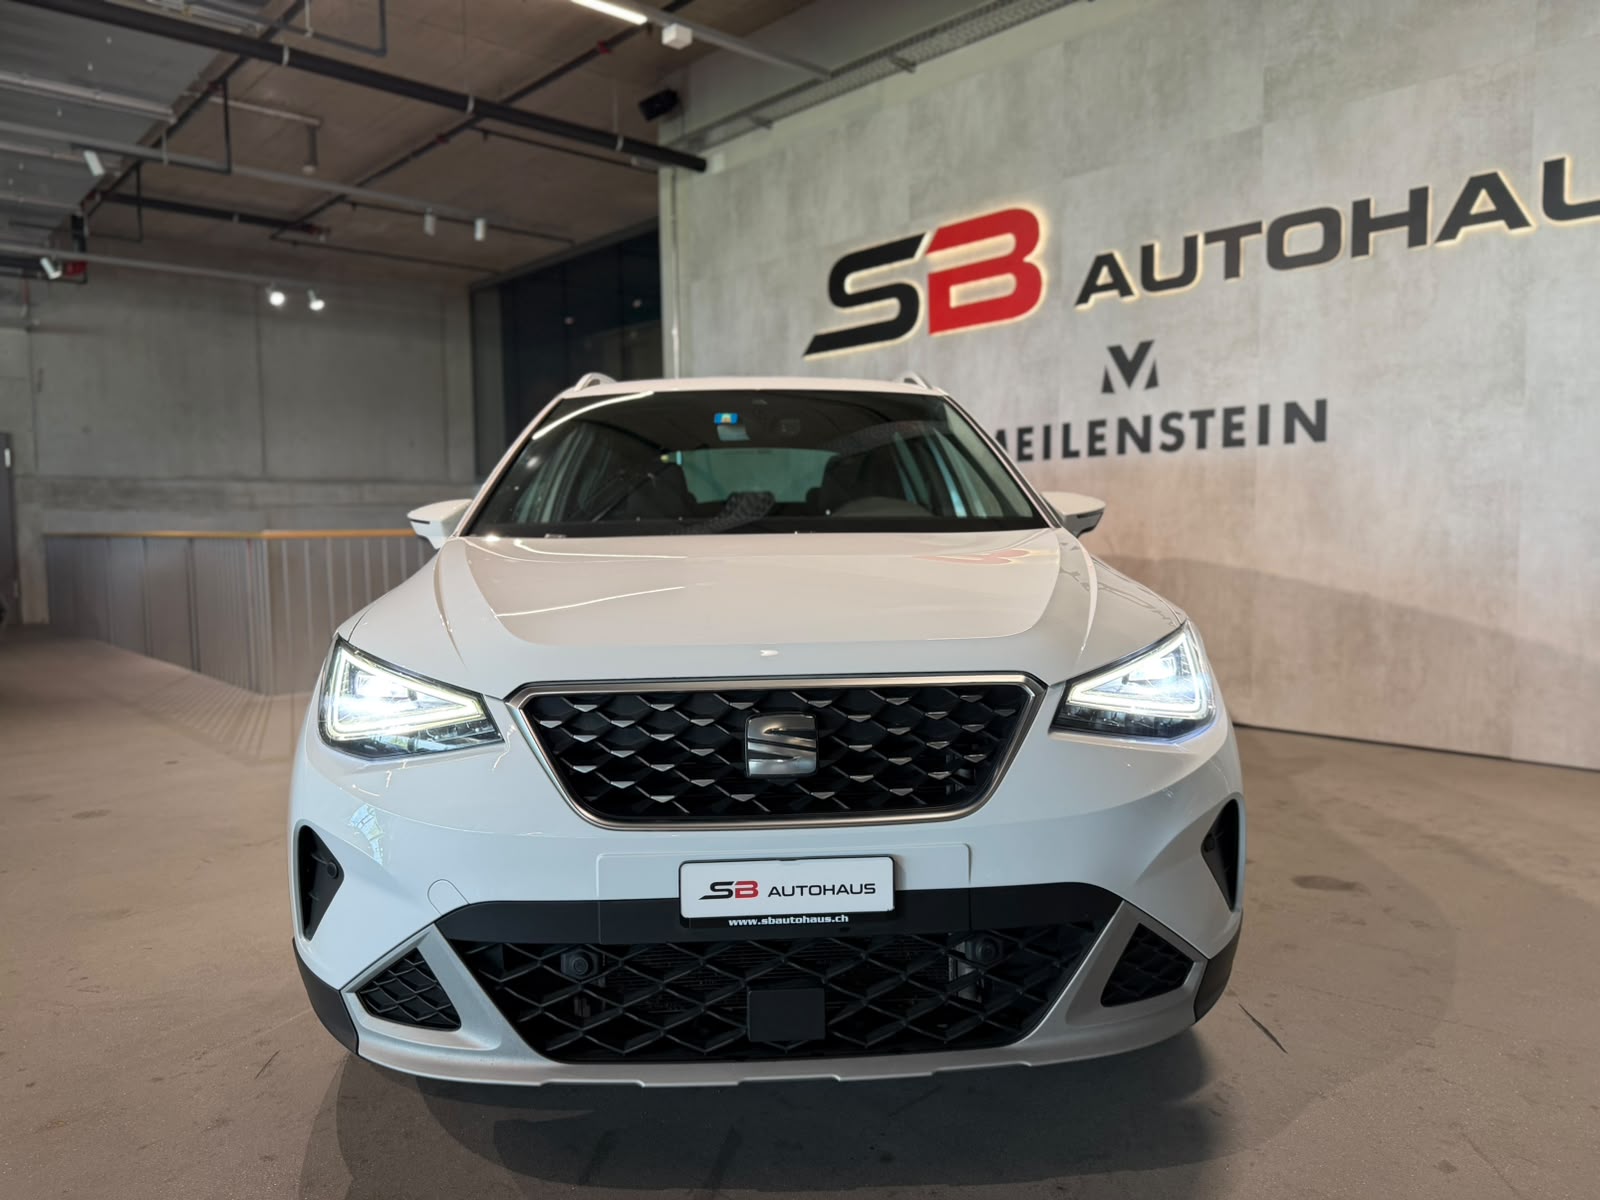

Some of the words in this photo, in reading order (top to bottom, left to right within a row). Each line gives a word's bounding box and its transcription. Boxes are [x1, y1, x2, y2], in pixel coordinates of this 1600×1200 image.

[803, 207, 1042, 357] SB
[698, 880, 759, 900] SB
[768, 883, 876, 898] AUTOHAUS
[728, 914, 849, 927] www.sbautohaus.ch
